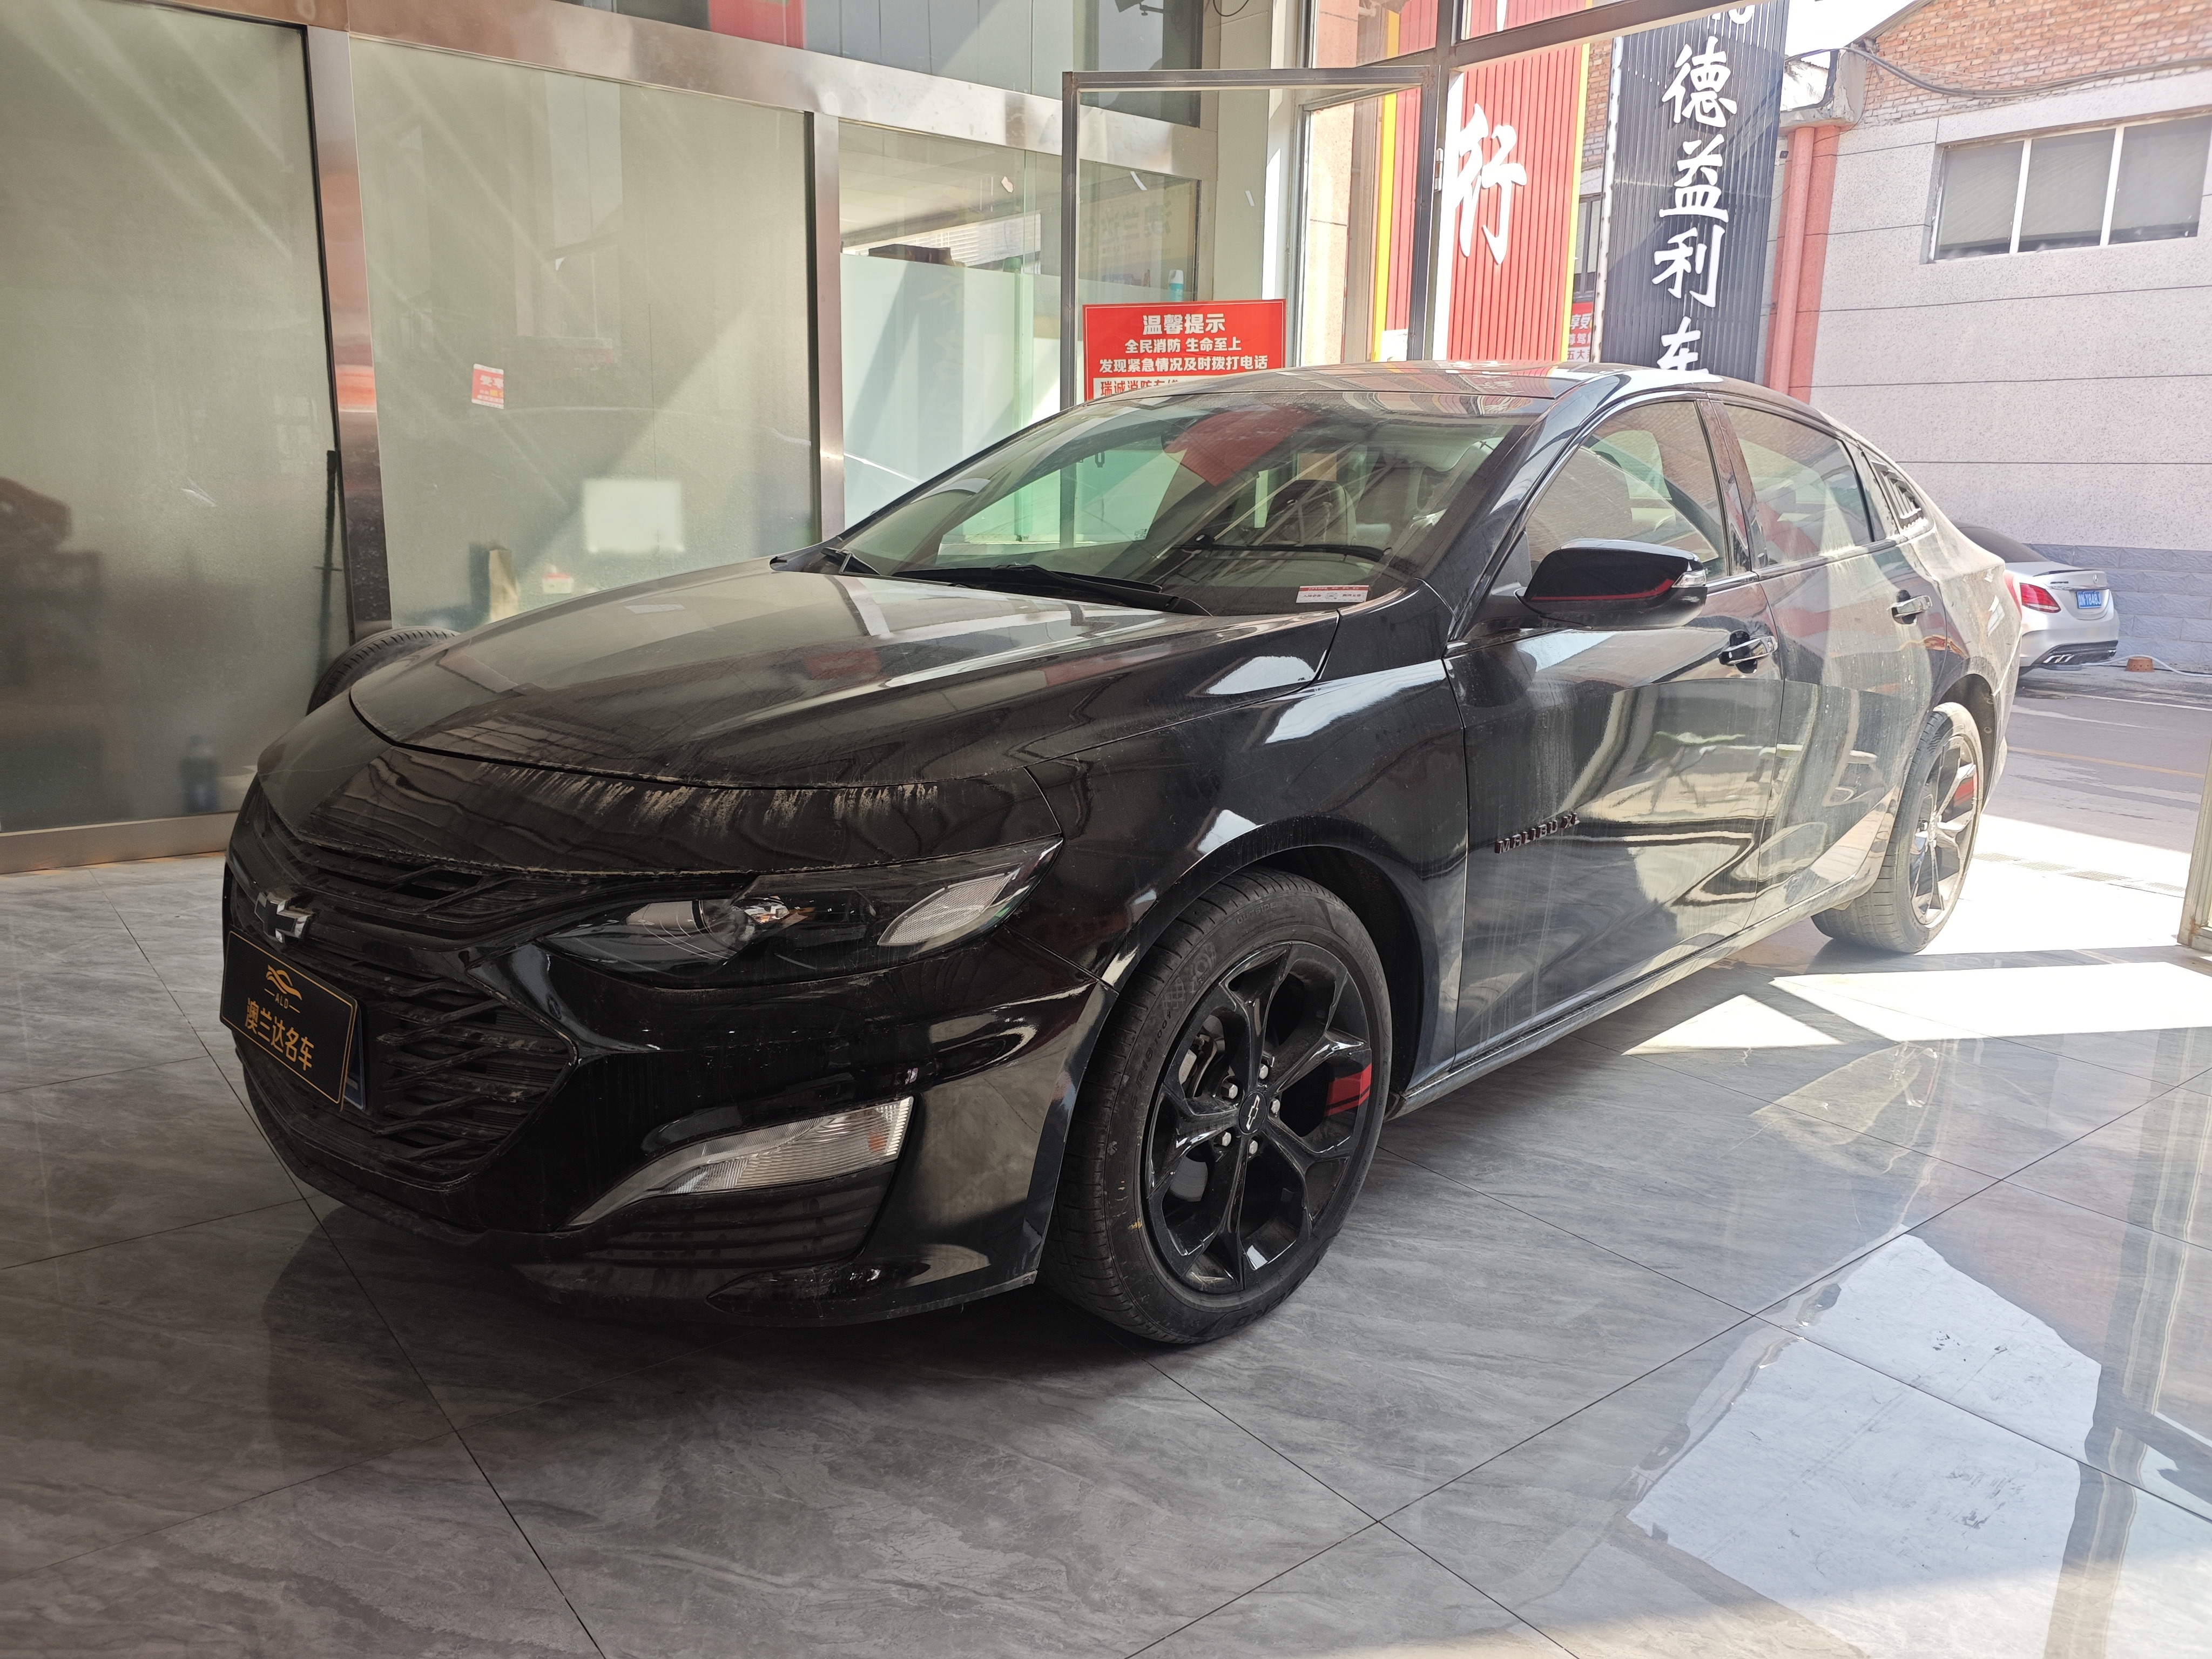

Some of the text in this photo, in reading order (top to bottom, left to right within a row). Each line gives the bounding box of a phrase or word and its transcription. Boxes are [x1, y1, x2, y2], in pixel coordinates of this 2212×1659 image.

[1142, 313, 1225, 335] 温馨提示
[1125, 337, 1242, 354] 全民消防 生命至上
[1100, 355, 1268, 374] 发现紧急情况及时拨打电话
[1495, 812, 1580, 854] MALIBU XL
[1236, 902, 1277, 925] OUTSIDE
[274, 993, 289, 1010] ALD
[245, 997, 314, 1071] 澳兰达名车
[1135, 1046, 1155, 1090] R18
[1154, 1009, 1172, 1046] 100Y
